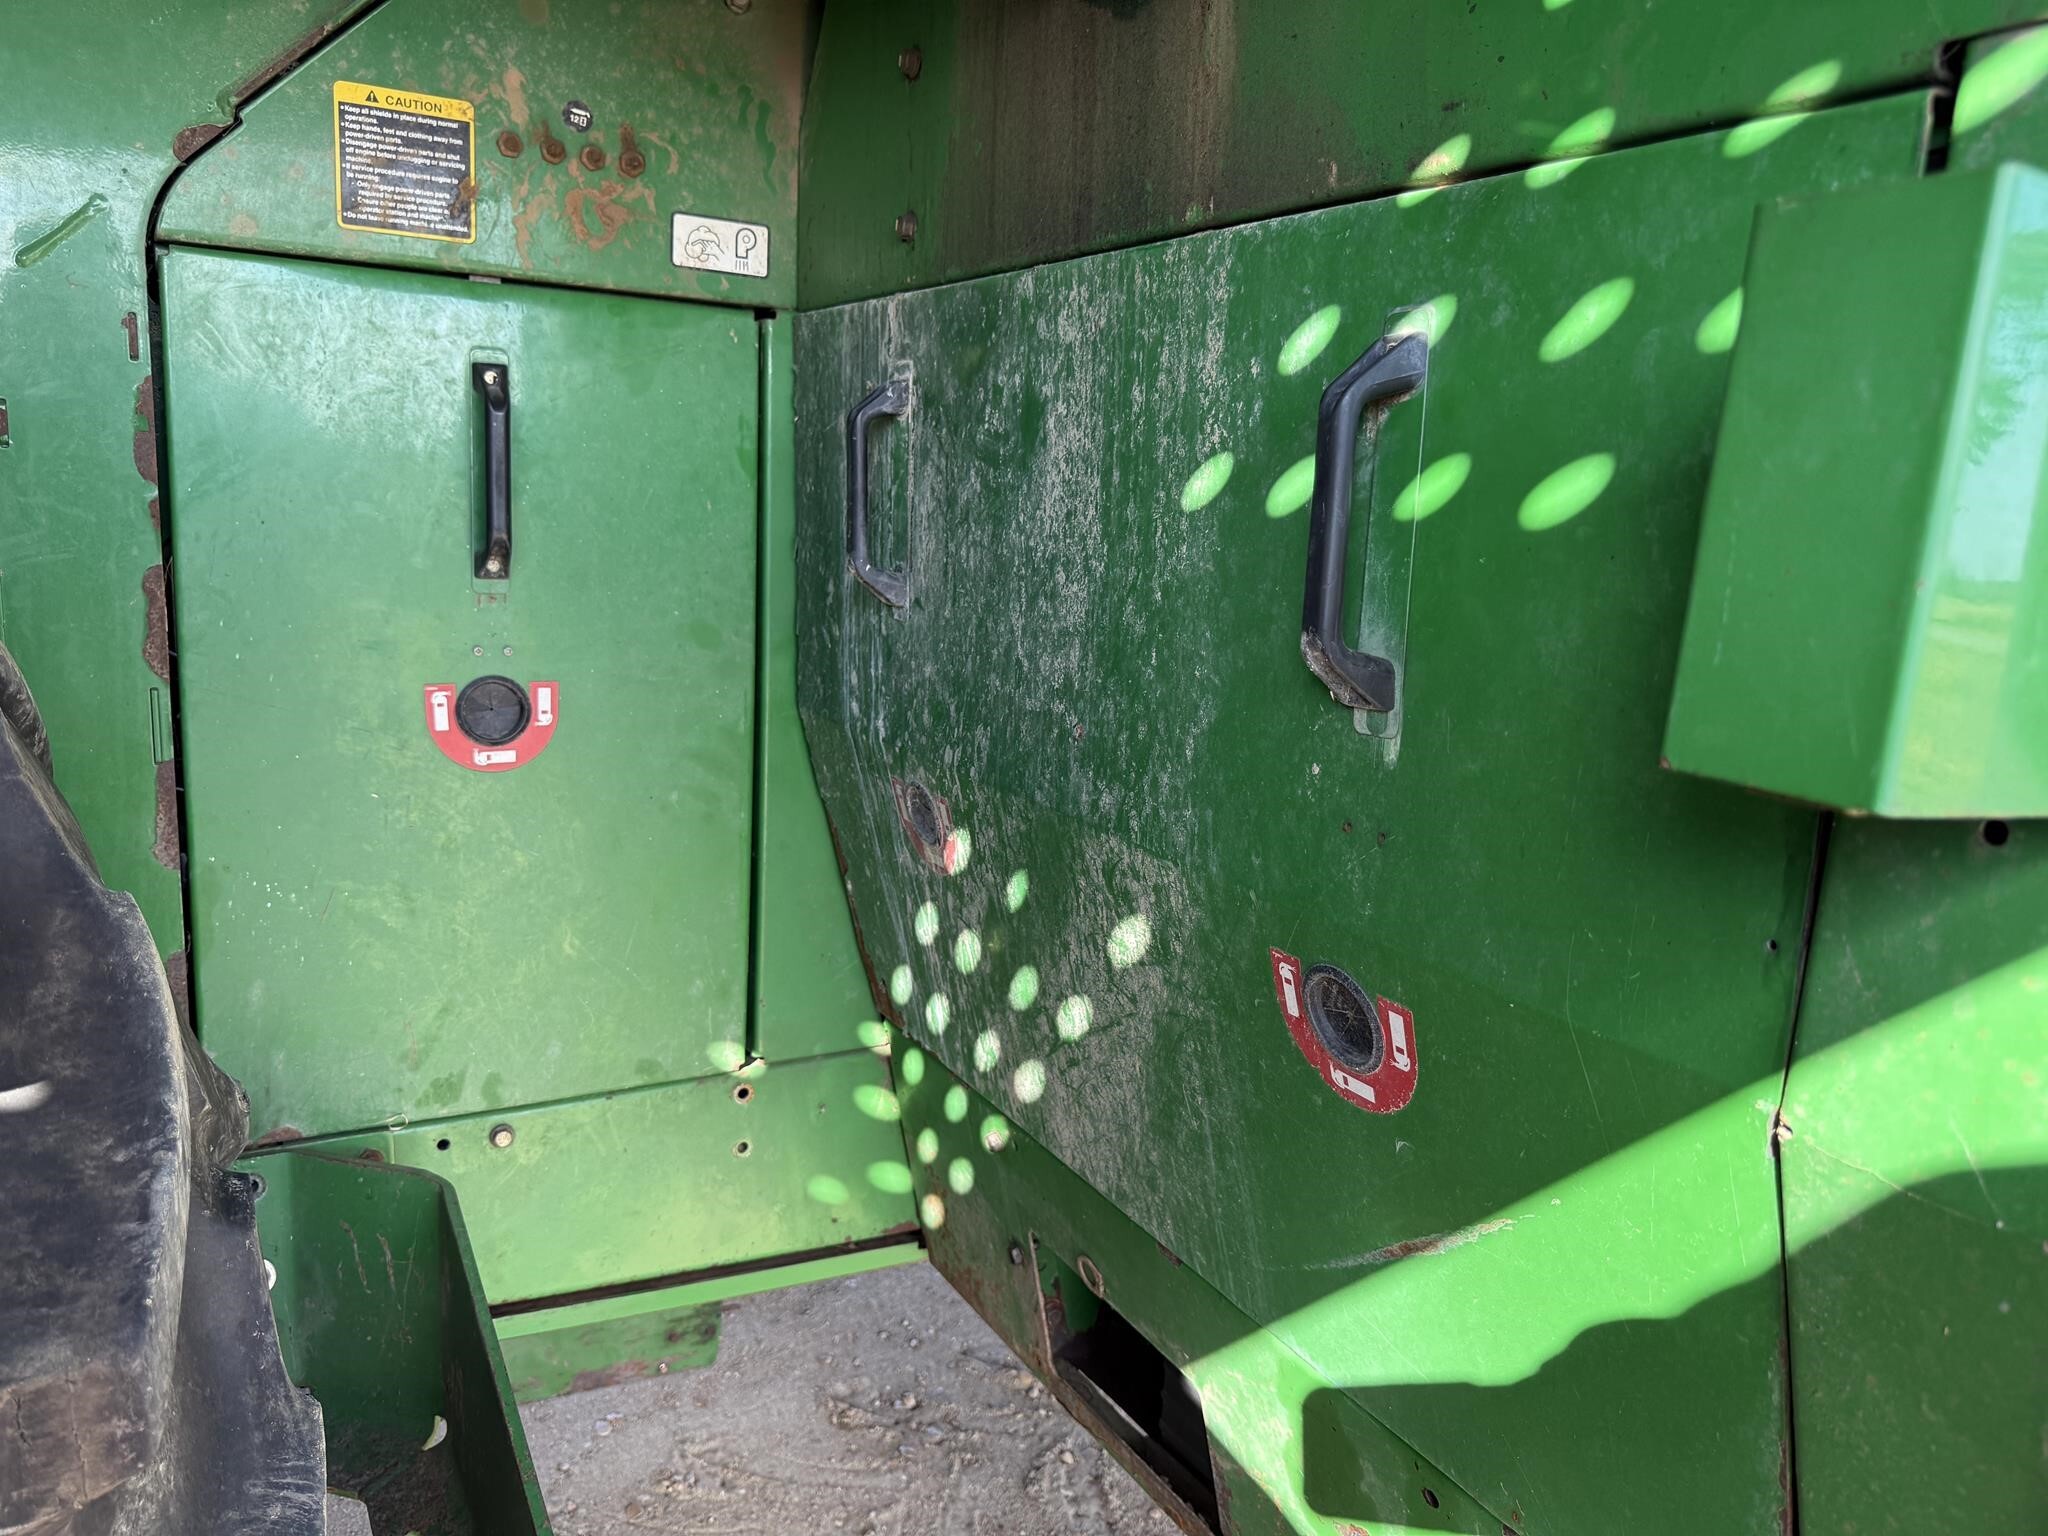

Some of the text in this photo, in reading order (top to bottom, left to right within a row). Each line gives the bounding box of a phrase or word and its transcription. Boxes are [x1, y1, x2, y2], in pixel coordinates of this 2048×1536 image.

[385, 96, 442, 113] CAUTION
[344, 105, 360, 114] Keep
[370, 108, 392, 118] shields
[417, 117, 437, 126] during
[345, 121, 360, 130] Keep
[408, 132, 432, 142] clothing
[434, 136, 448, 144] away
[345, 131, 384, 141] power-driven
[346, 138, 377, 149] Disengage
[378, 144, 417, 154] power-driven
[377, 151, 396, 159] before
[439, 161, 465, 171] servicing
[374, 168, 405, 177] procedure
[357, 181, 370, 189] Only
